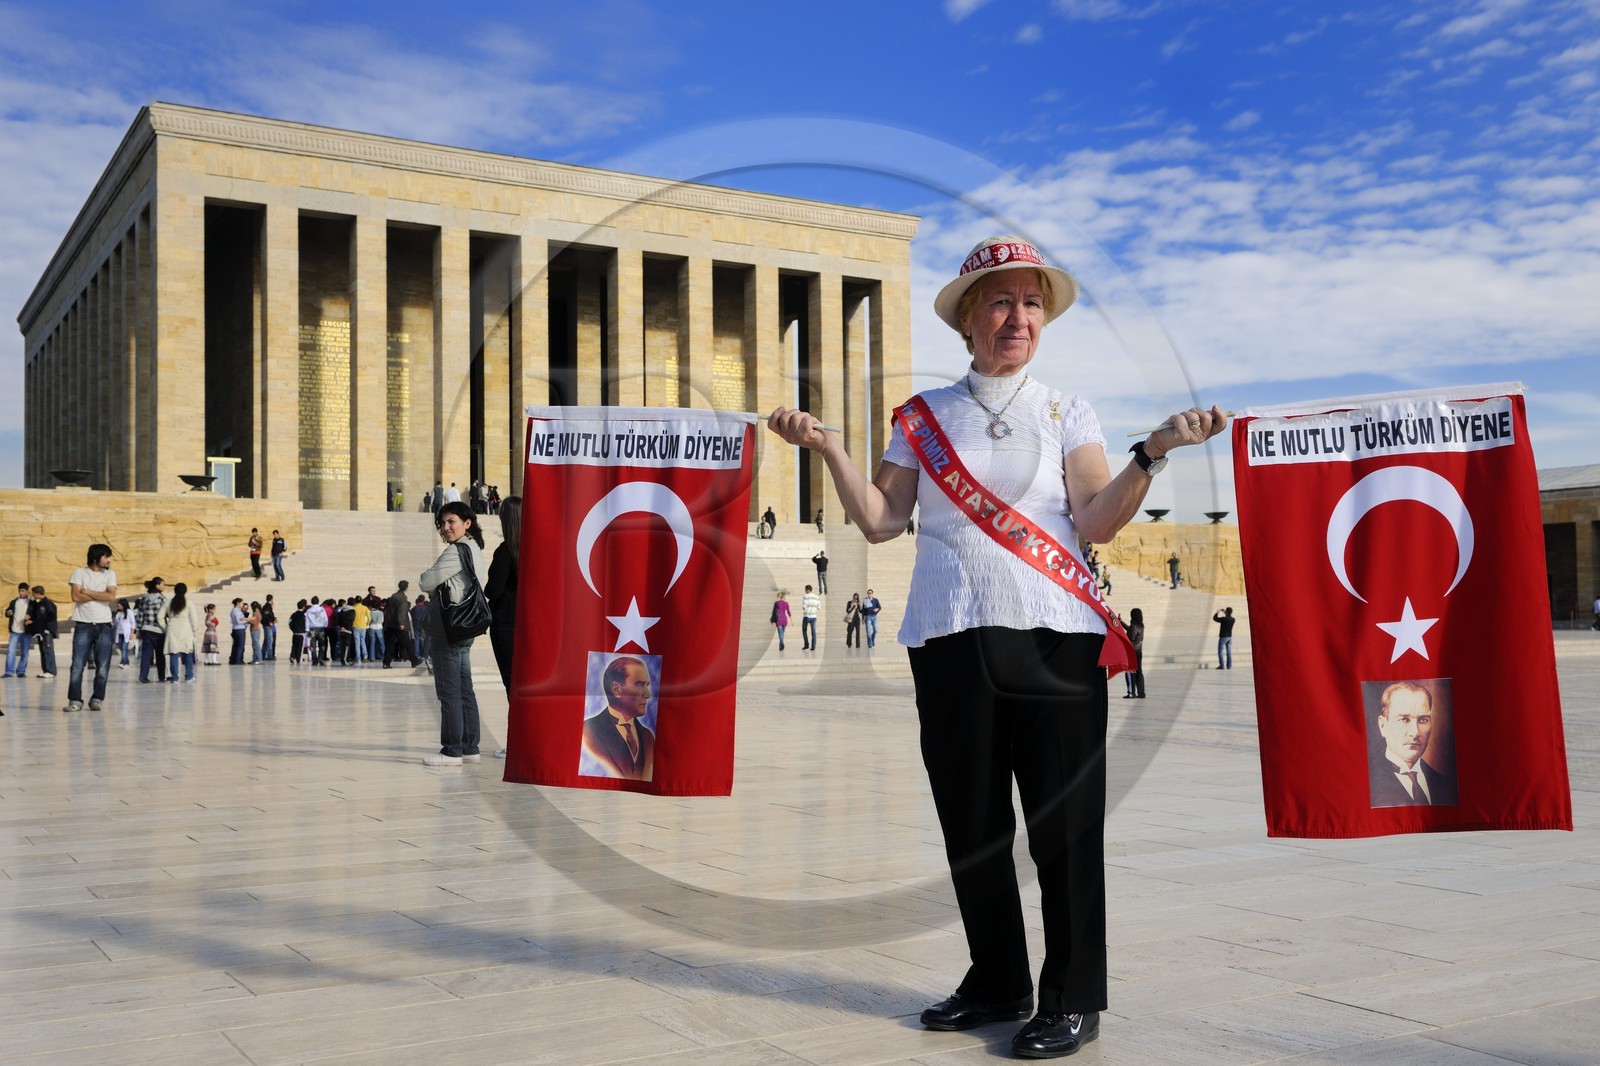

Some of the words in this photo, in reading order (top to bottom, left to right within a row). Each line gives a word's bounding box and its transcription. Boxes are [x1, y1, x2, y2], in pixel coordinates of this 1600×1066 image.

[532, 432, 555, 457] NE
[557, 432, 611, 459] MUTLU
[615, 429, 680, 461] TÜRKÜM
[683, 429, 743, 462] DİYENE
[901, 402, 950, 475] HEPİMİZ
[1251, 430, 1276, 458] NE
[1280, 426, 1345, 458] MUTLU
[1350, 413, 1435, 451] TÜRKÜM
[1441, 409, 1512, 443] DİYENE
